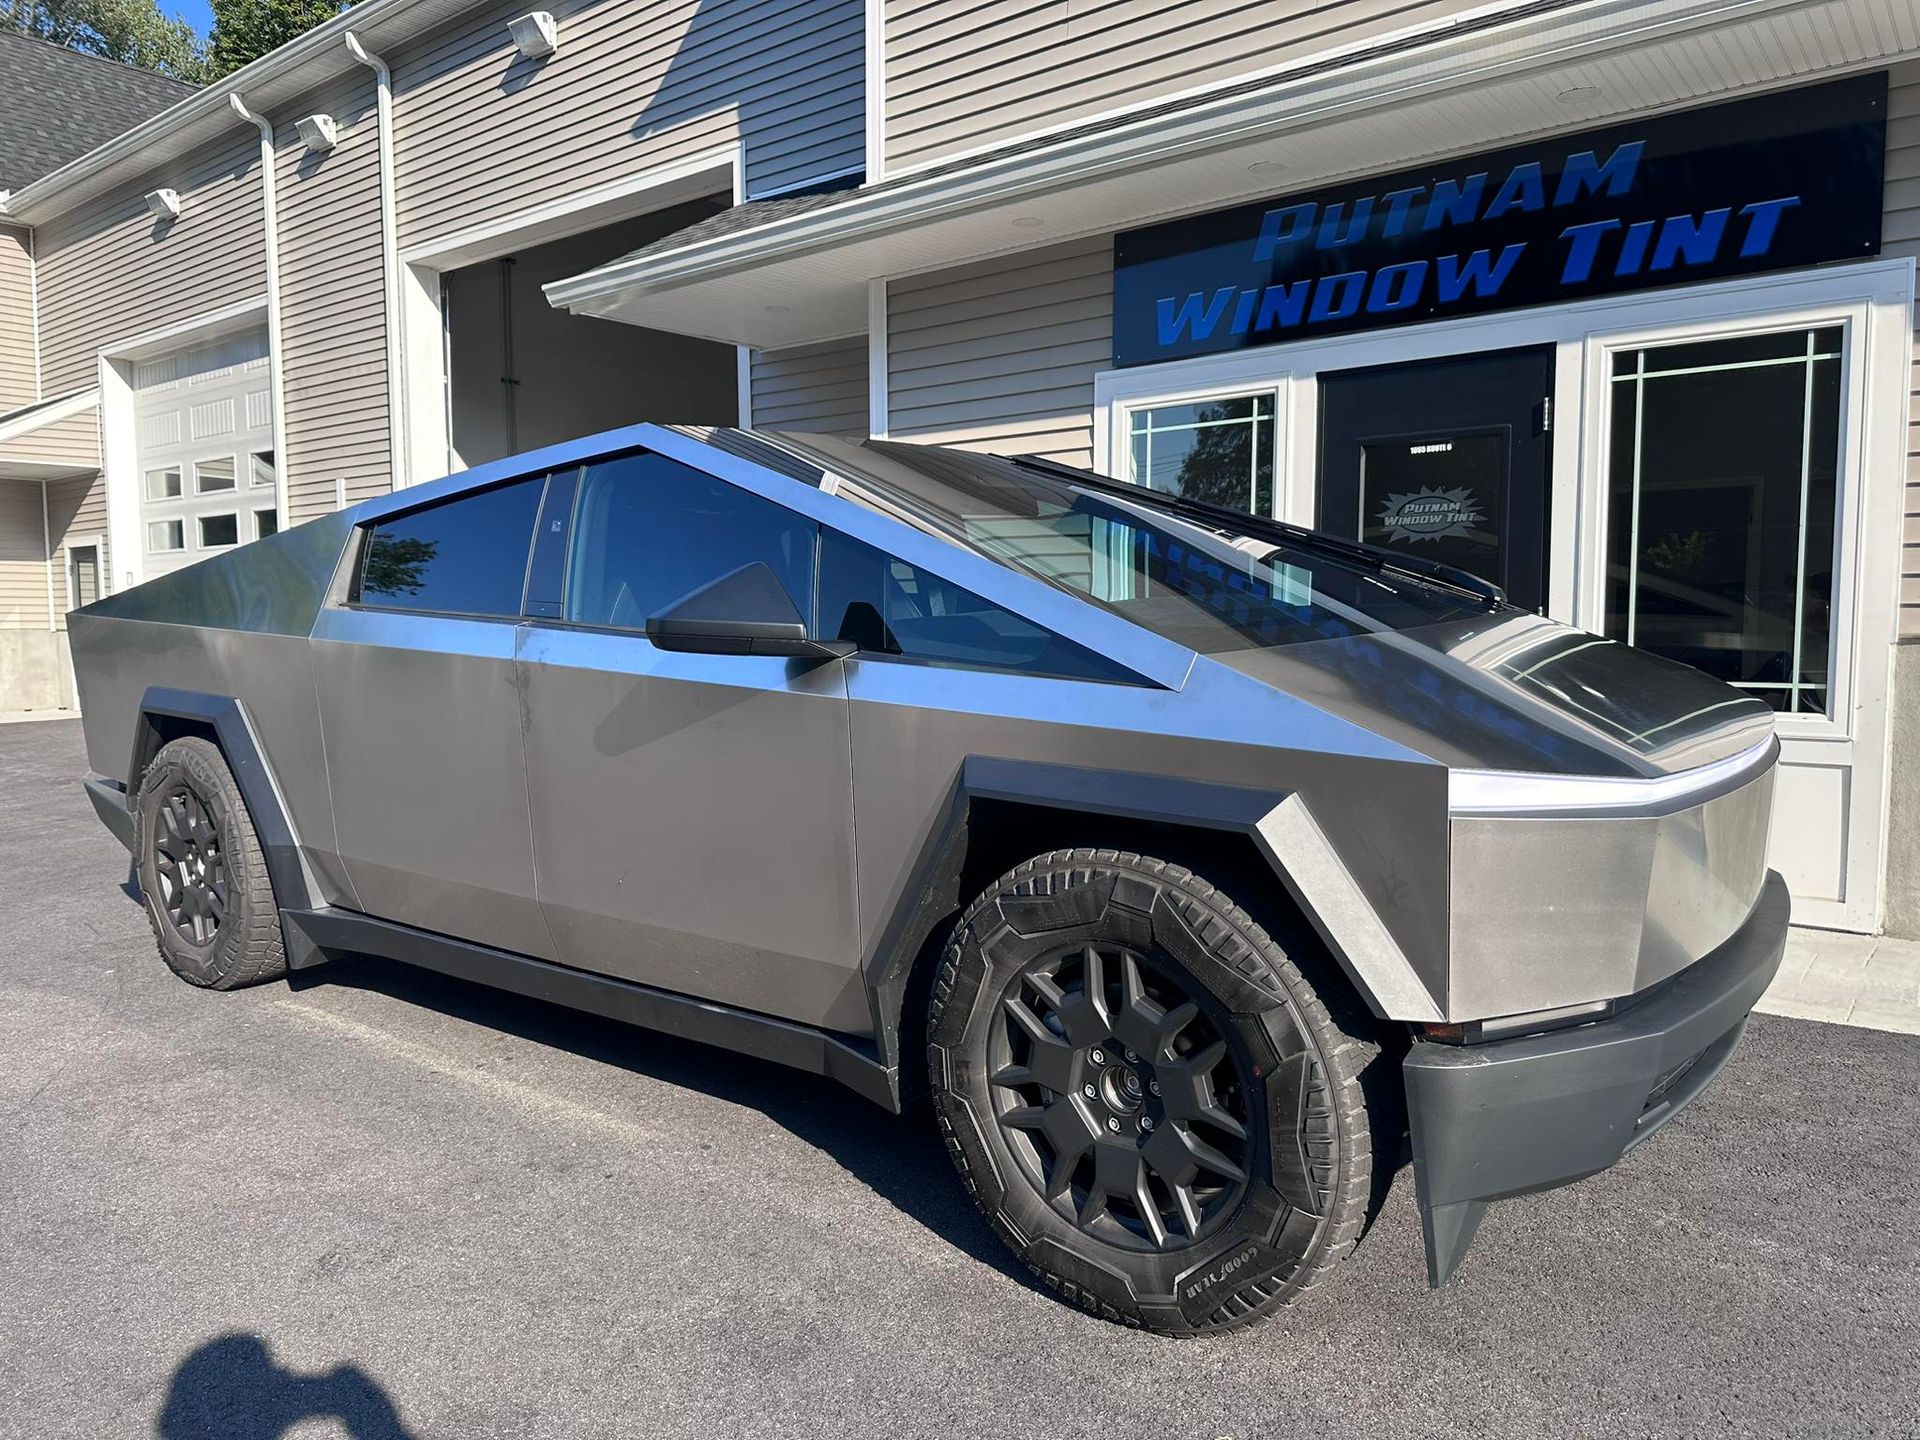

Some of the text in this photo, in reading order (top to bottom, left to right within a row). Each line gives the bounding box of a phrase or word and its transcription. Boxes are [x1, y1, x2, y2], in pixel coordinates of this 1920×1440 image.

[1252, 140, 1647, 263] PUTNAM
[1156, 195, 1801, 346] WINDOW TINT
[1384, 512, 1477, 526] WINDOW TINT
[1403, 502, 1461, 514] PUTNAM
